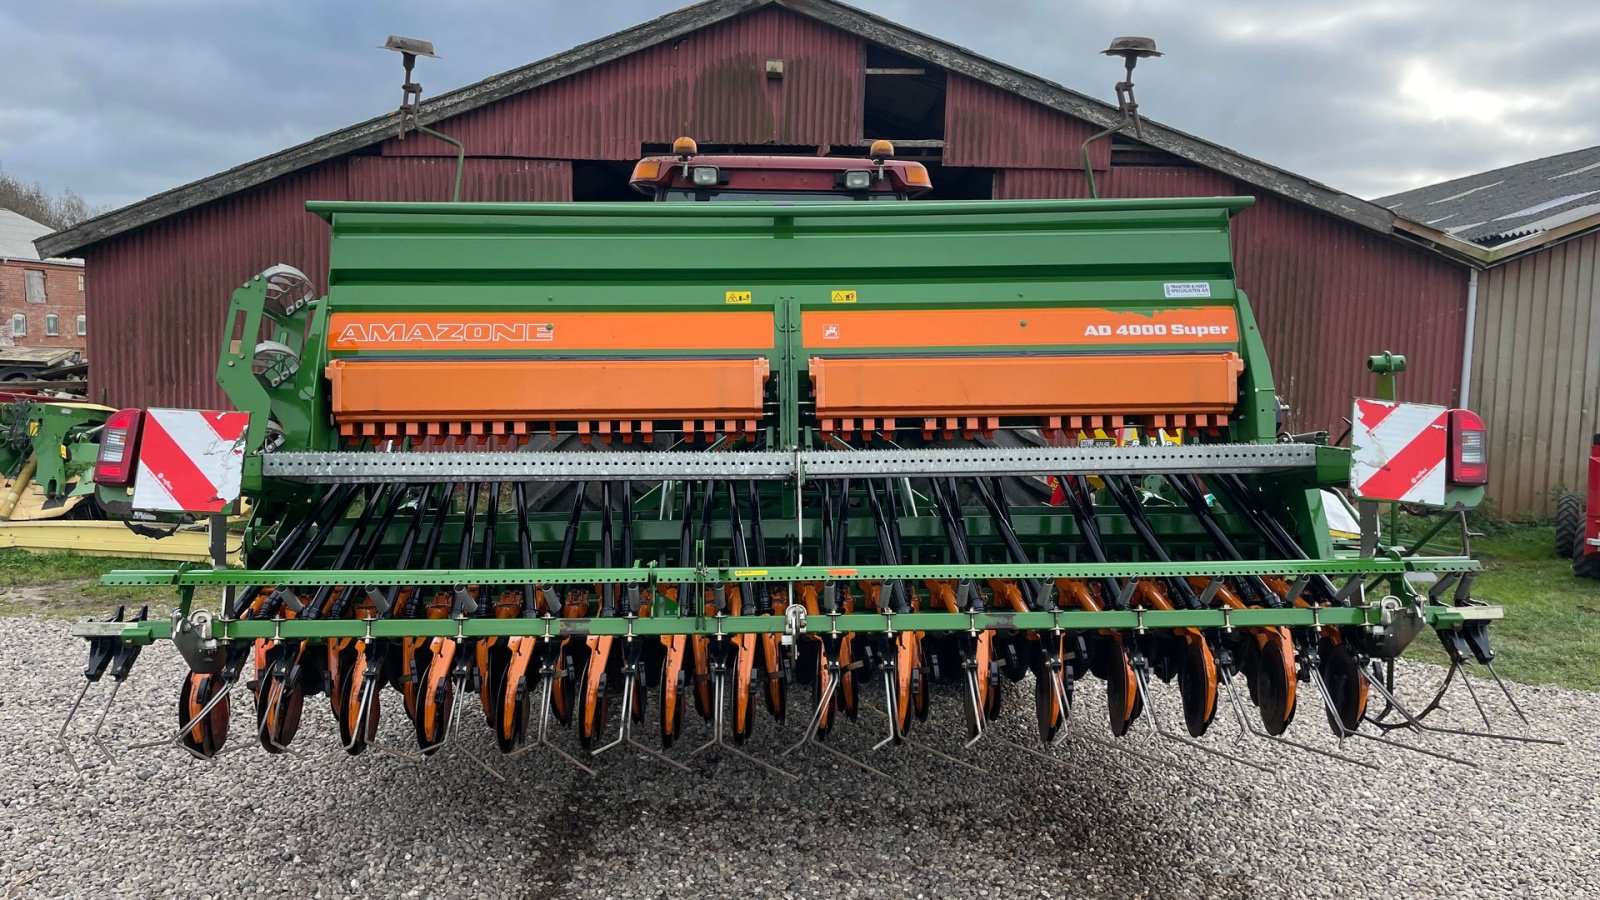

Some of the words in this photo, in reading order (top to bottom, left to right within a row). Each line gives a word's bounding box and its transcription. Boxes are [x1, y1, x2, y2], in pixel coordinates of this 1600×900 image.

[337, 323, 554, 342] AMAZONE
[1084, 324, 1112, 336] AD
[1115, 324, 1167, 336] 4000
[1171, 324, 1229, 337] Super
